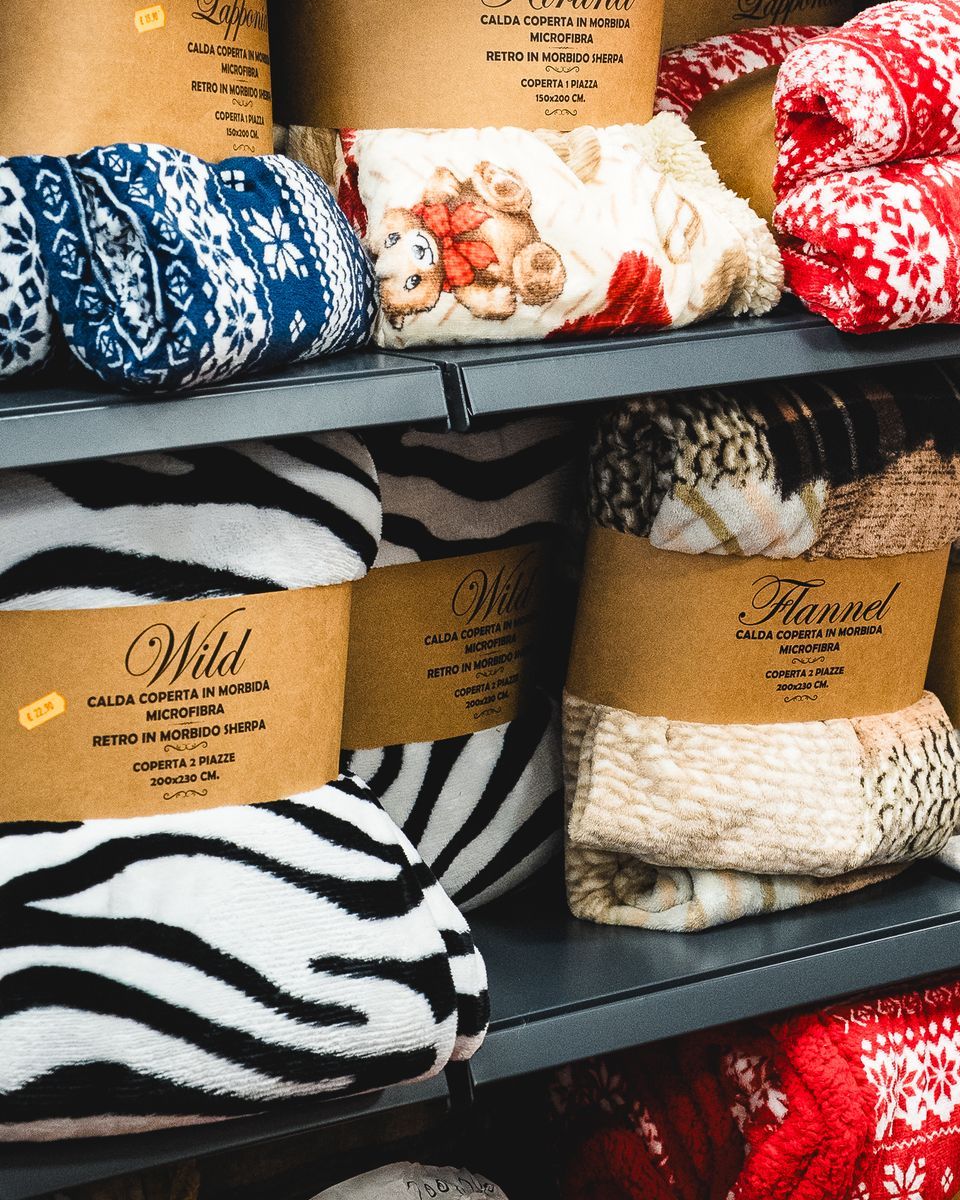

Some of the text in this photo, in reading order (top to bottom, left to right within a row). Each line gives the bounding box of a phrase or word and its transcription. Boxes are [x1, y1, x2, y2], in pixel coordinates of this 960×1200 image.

[480, 14, 630, 28] CALDA COPERTA IN MORBIDA
[530, 32, 594, 44] MICROFIBRA
[188, 42, 247, 60] CALDA COPERTA
[486, 51, 624, 64] RETRO IN MORBIDO SHERPA
[221, 63, 259, 78] MICROFIBRA
[191, 80, 258, 99] RETRO IN MORBIDO
[520, 78, 598, 89] COPERTA PIAZZA
[535, 94, 586, 103] 150x200 CM.
[215, 110, 265, 126] COPERTA PIAZZA
[226, 127, 250, 138] 150x200
[452, 557, 534, 625] Wild
[738, 574, 901, 626] Flannel
[424, 623, 501, 646] CALDA COPERTA
[735, 625, 883, 640] CALDA COPERTA IN MORBIDA
[124, 607, 252, 688] Wild
[464, 634, 517, 655] MICROFIBRA
[779, 642, 841, 655] MICROFIBRA
[427, 652, 513, 679] RETRO IN MORBIDO
[765, 666, 845, 679] COPERTA PIAZZE
[87, 679, 270, 708] CALDA COPERTA IN MORBIDA
[454, 684, 490, 698] COPERTA
[776, 680, 829, 691] 200x230 CM.
[146, 703, 225, 721] MICROFIBRA
[92, 719, 267, 747] RETRO IN MORBIDO SHERPA
[132, 752, 236, 772] COPERTA PIAZZE
[150, 770, 220, 786] 200x230 CM.
